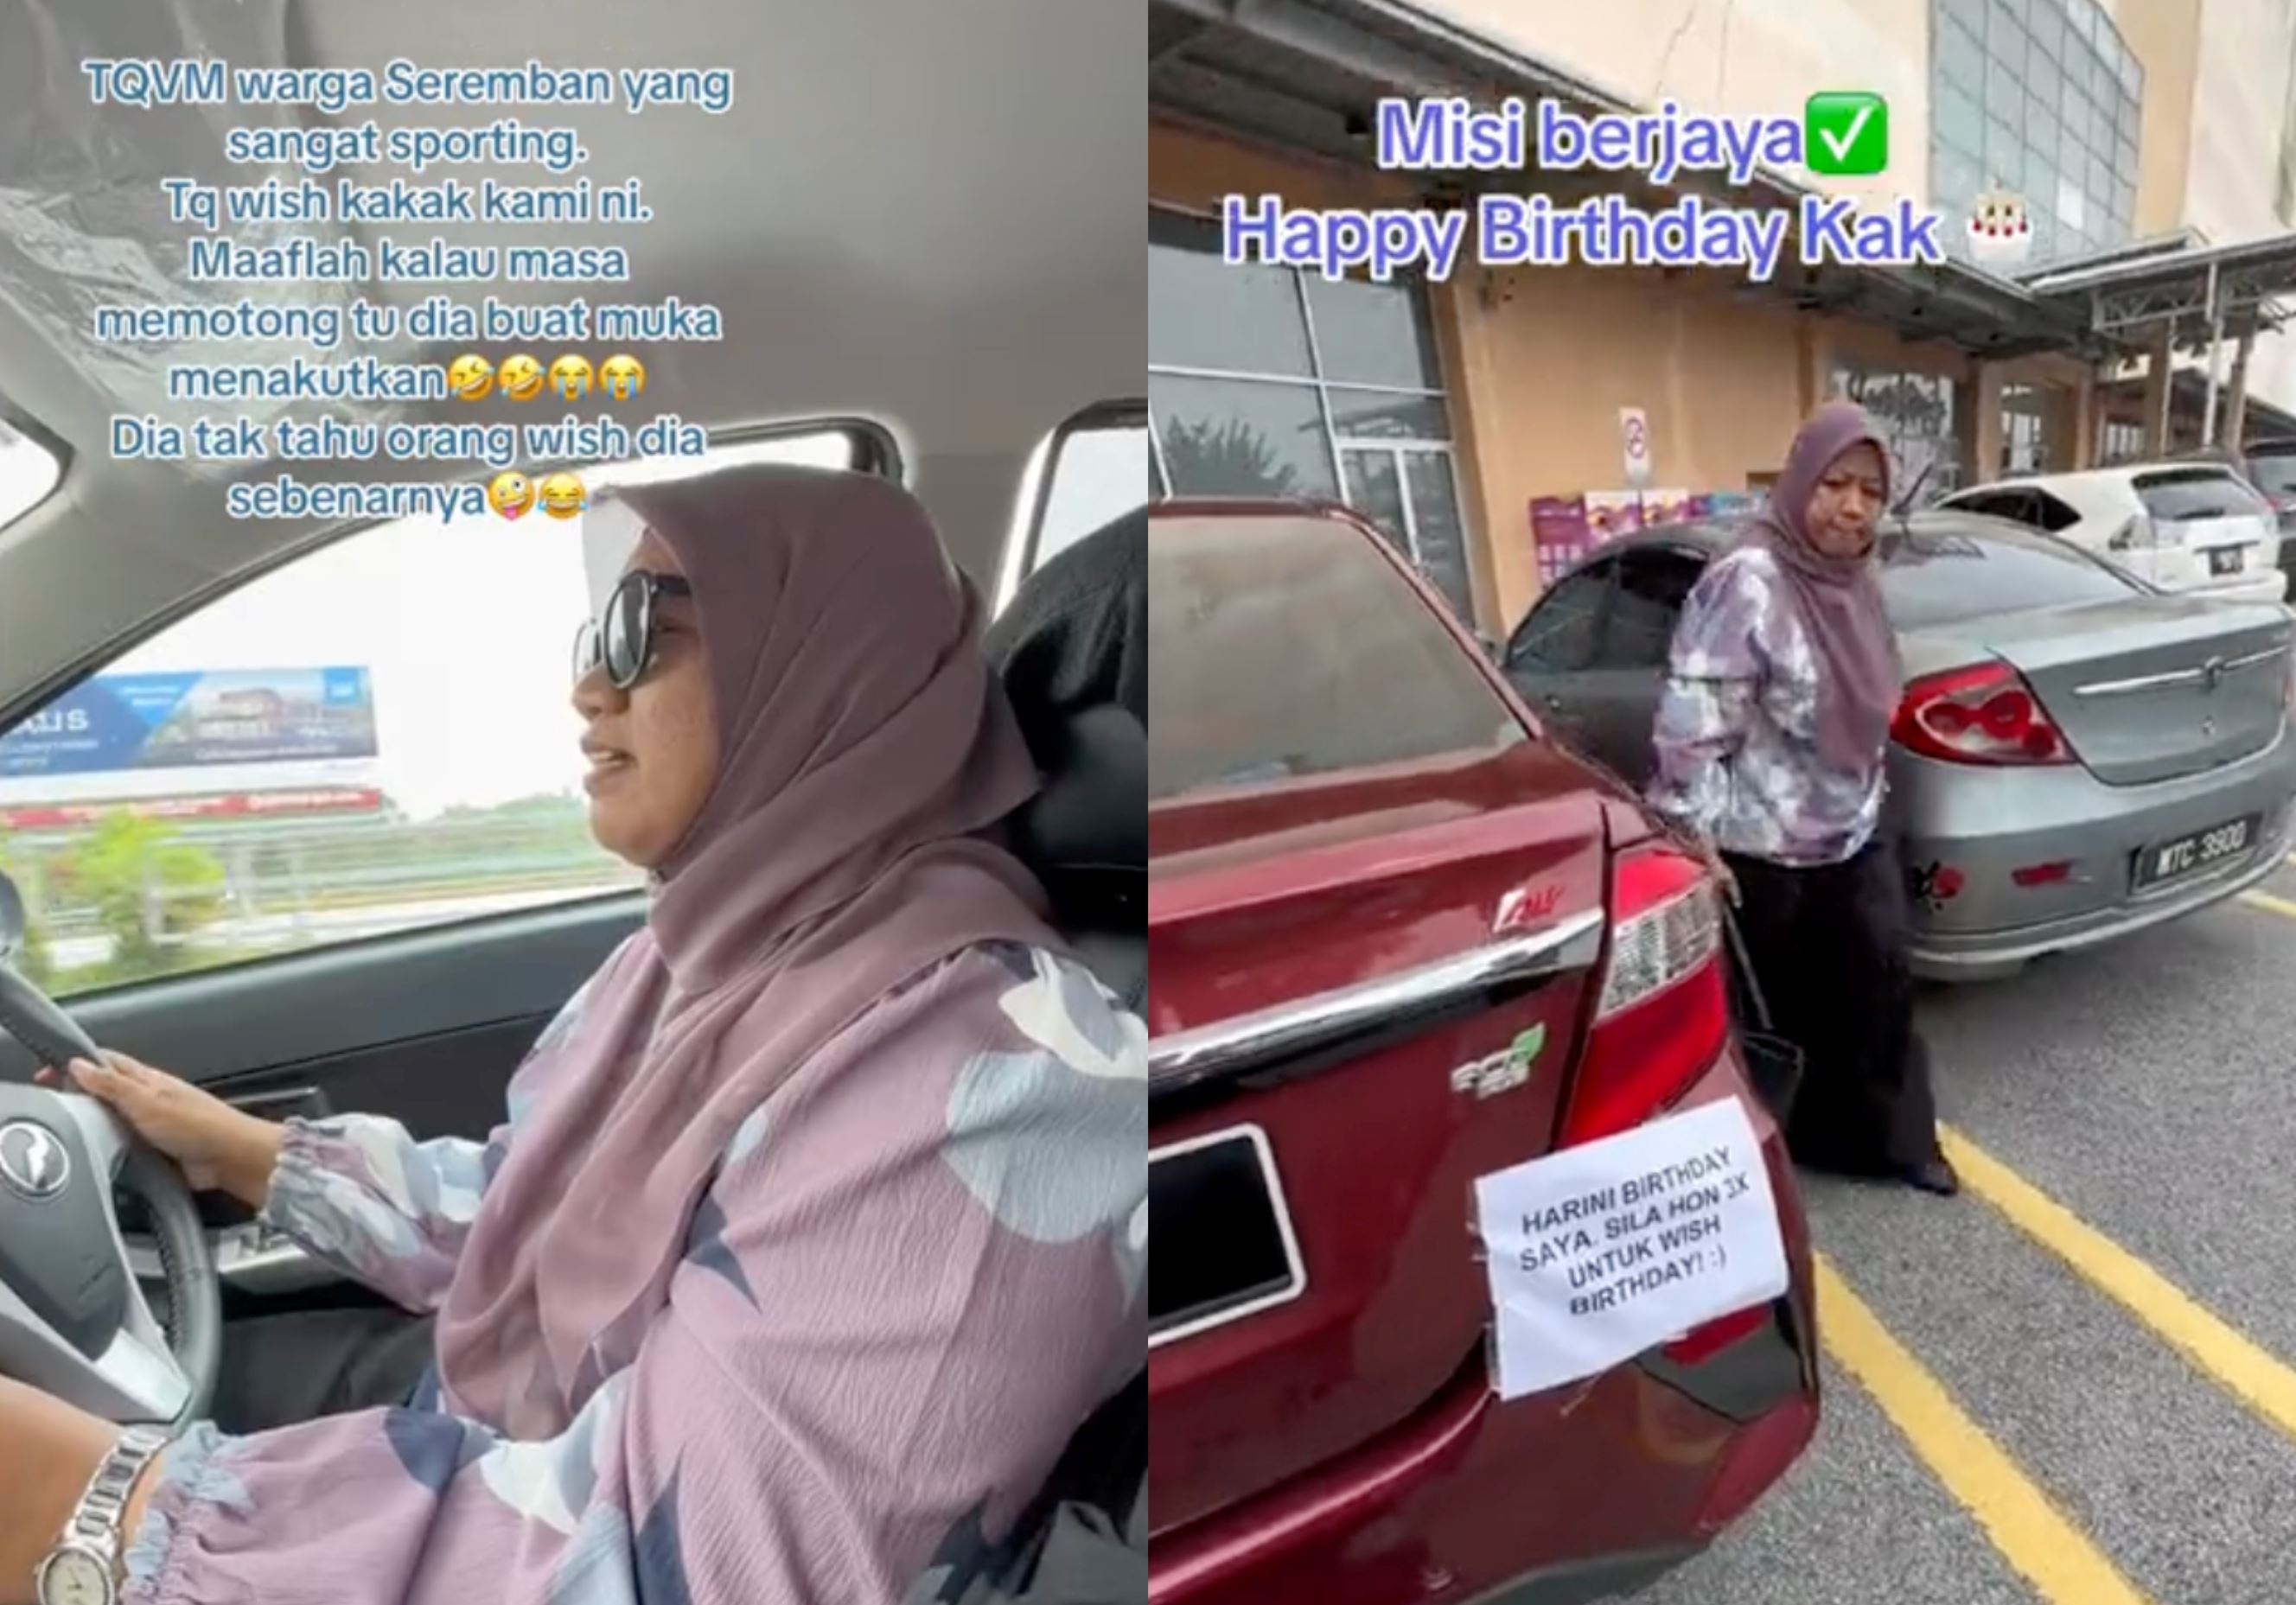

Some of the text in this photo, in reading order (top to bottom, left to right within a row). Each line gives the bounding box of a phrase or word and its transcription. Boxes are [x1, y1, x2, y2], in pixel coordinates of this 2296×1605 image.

[1521, 1144, 1733, 1237] HARINI BIRTHDAY
[1605, 1206, 1663, 1241] SILA
[1668, 1188, 1721, 1219] HON
[1568, 1214, 1722, 1290] UNTUK WISH
[1569, 1251, 1705, 1316] BIRTHDAY!
